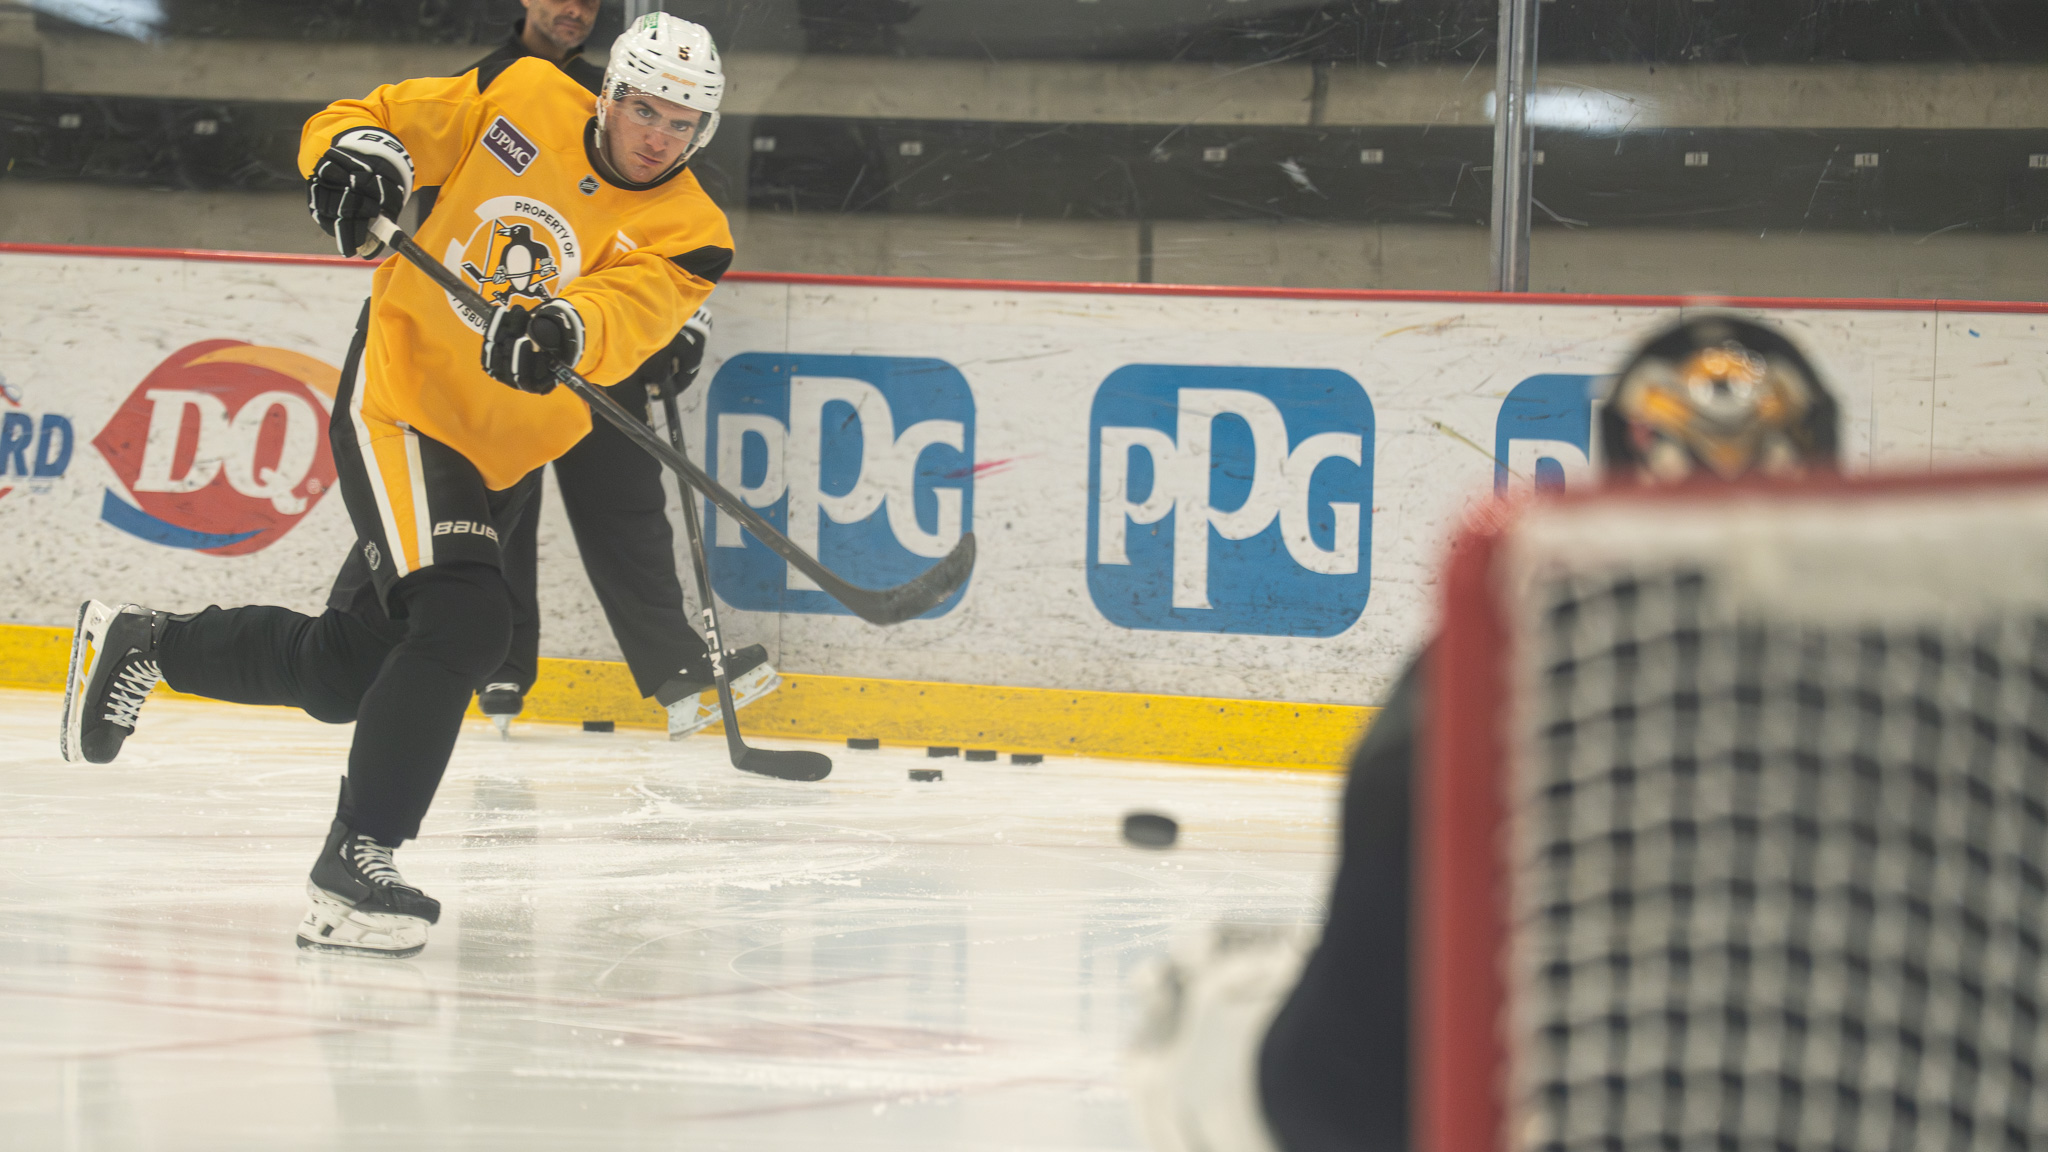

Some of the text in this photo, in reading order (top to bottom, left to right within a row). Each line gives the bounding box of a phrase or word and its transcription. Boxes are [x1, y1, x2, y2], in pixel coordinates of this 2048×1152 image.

[679, 46, 690, 60] 5
[488, 124, 532, 166] UPMC
[514, 201, 575, 258] PROPERTY OF
[133, 388, 319, 515] DQ
[716, 376, 964, 591] PPG
[1098, 387, 1362, 609] PPG
[702, 608, 724, 677] CCM
